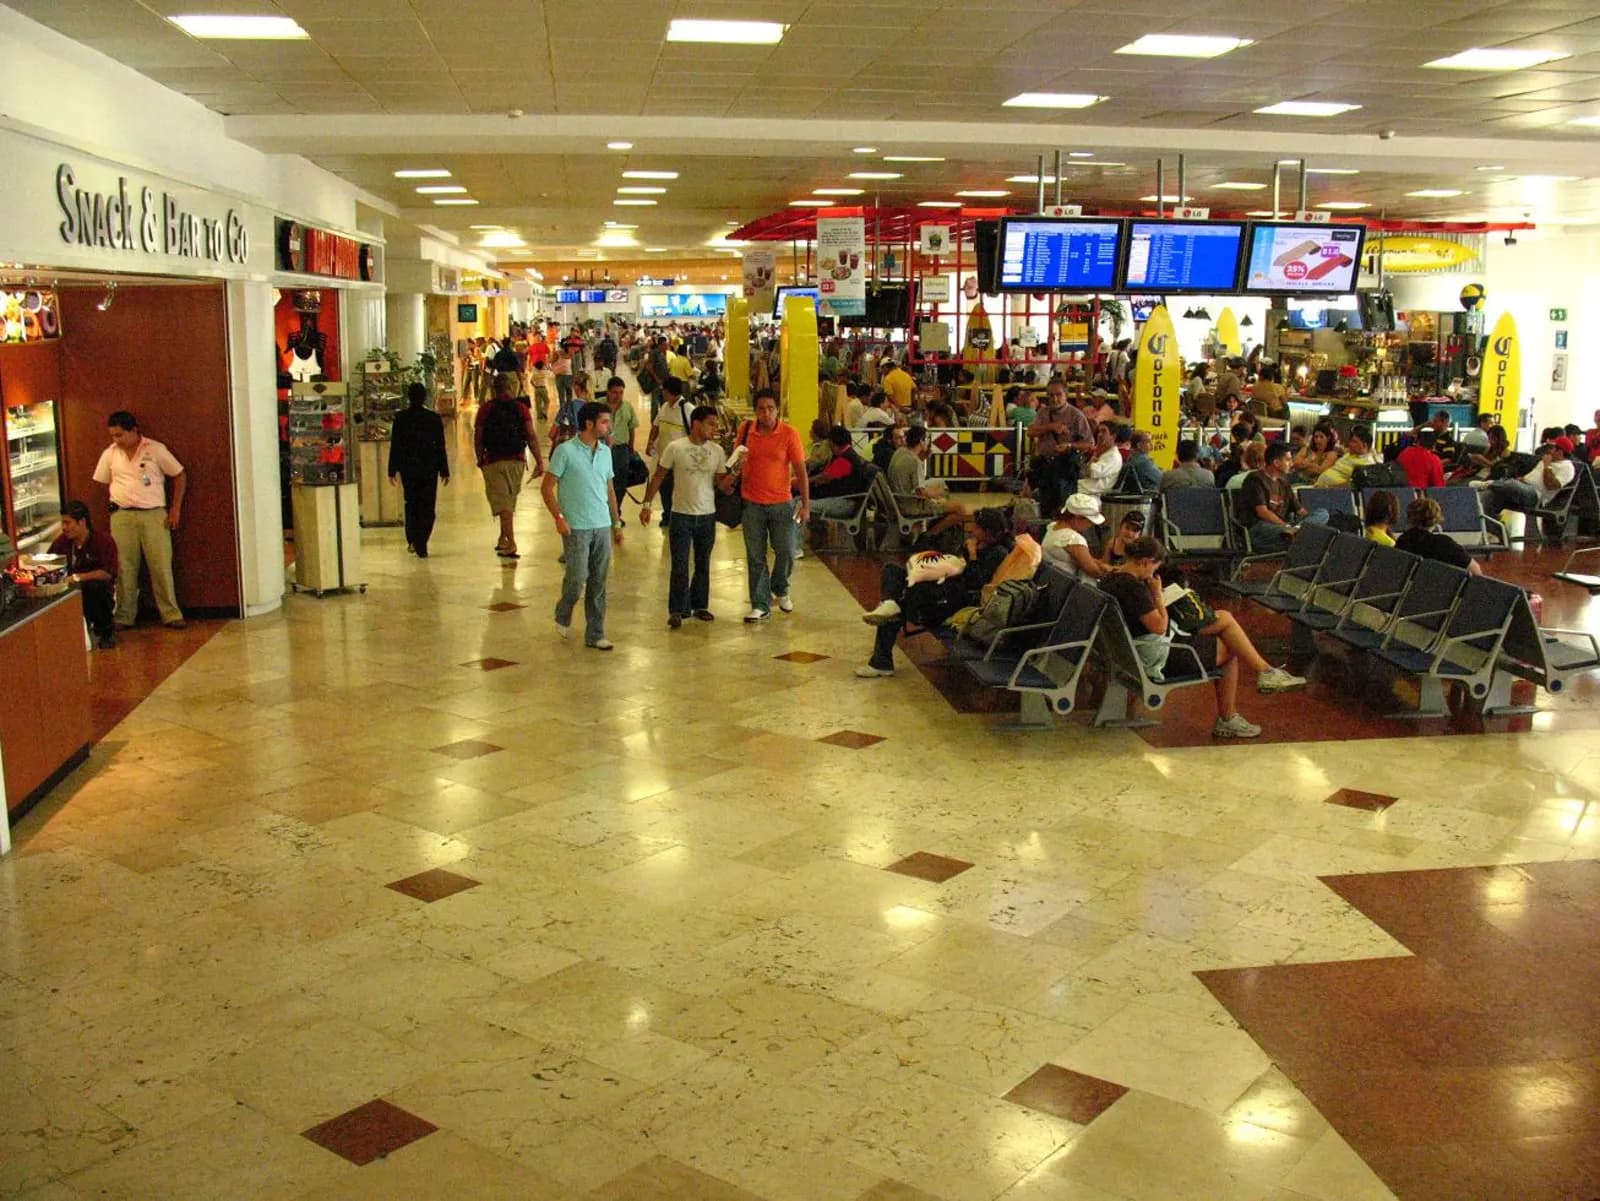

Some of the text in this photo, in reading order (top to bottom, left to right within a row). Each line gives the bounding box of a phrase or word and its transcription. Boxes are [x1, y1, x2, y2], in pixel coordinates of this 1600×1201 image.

[140, 186, 159, 254] &
[163, 192, 201, 257] BAR
[1147, 332, 1169, 427] Corona
[1494, 336, 1512, 425] Corona
